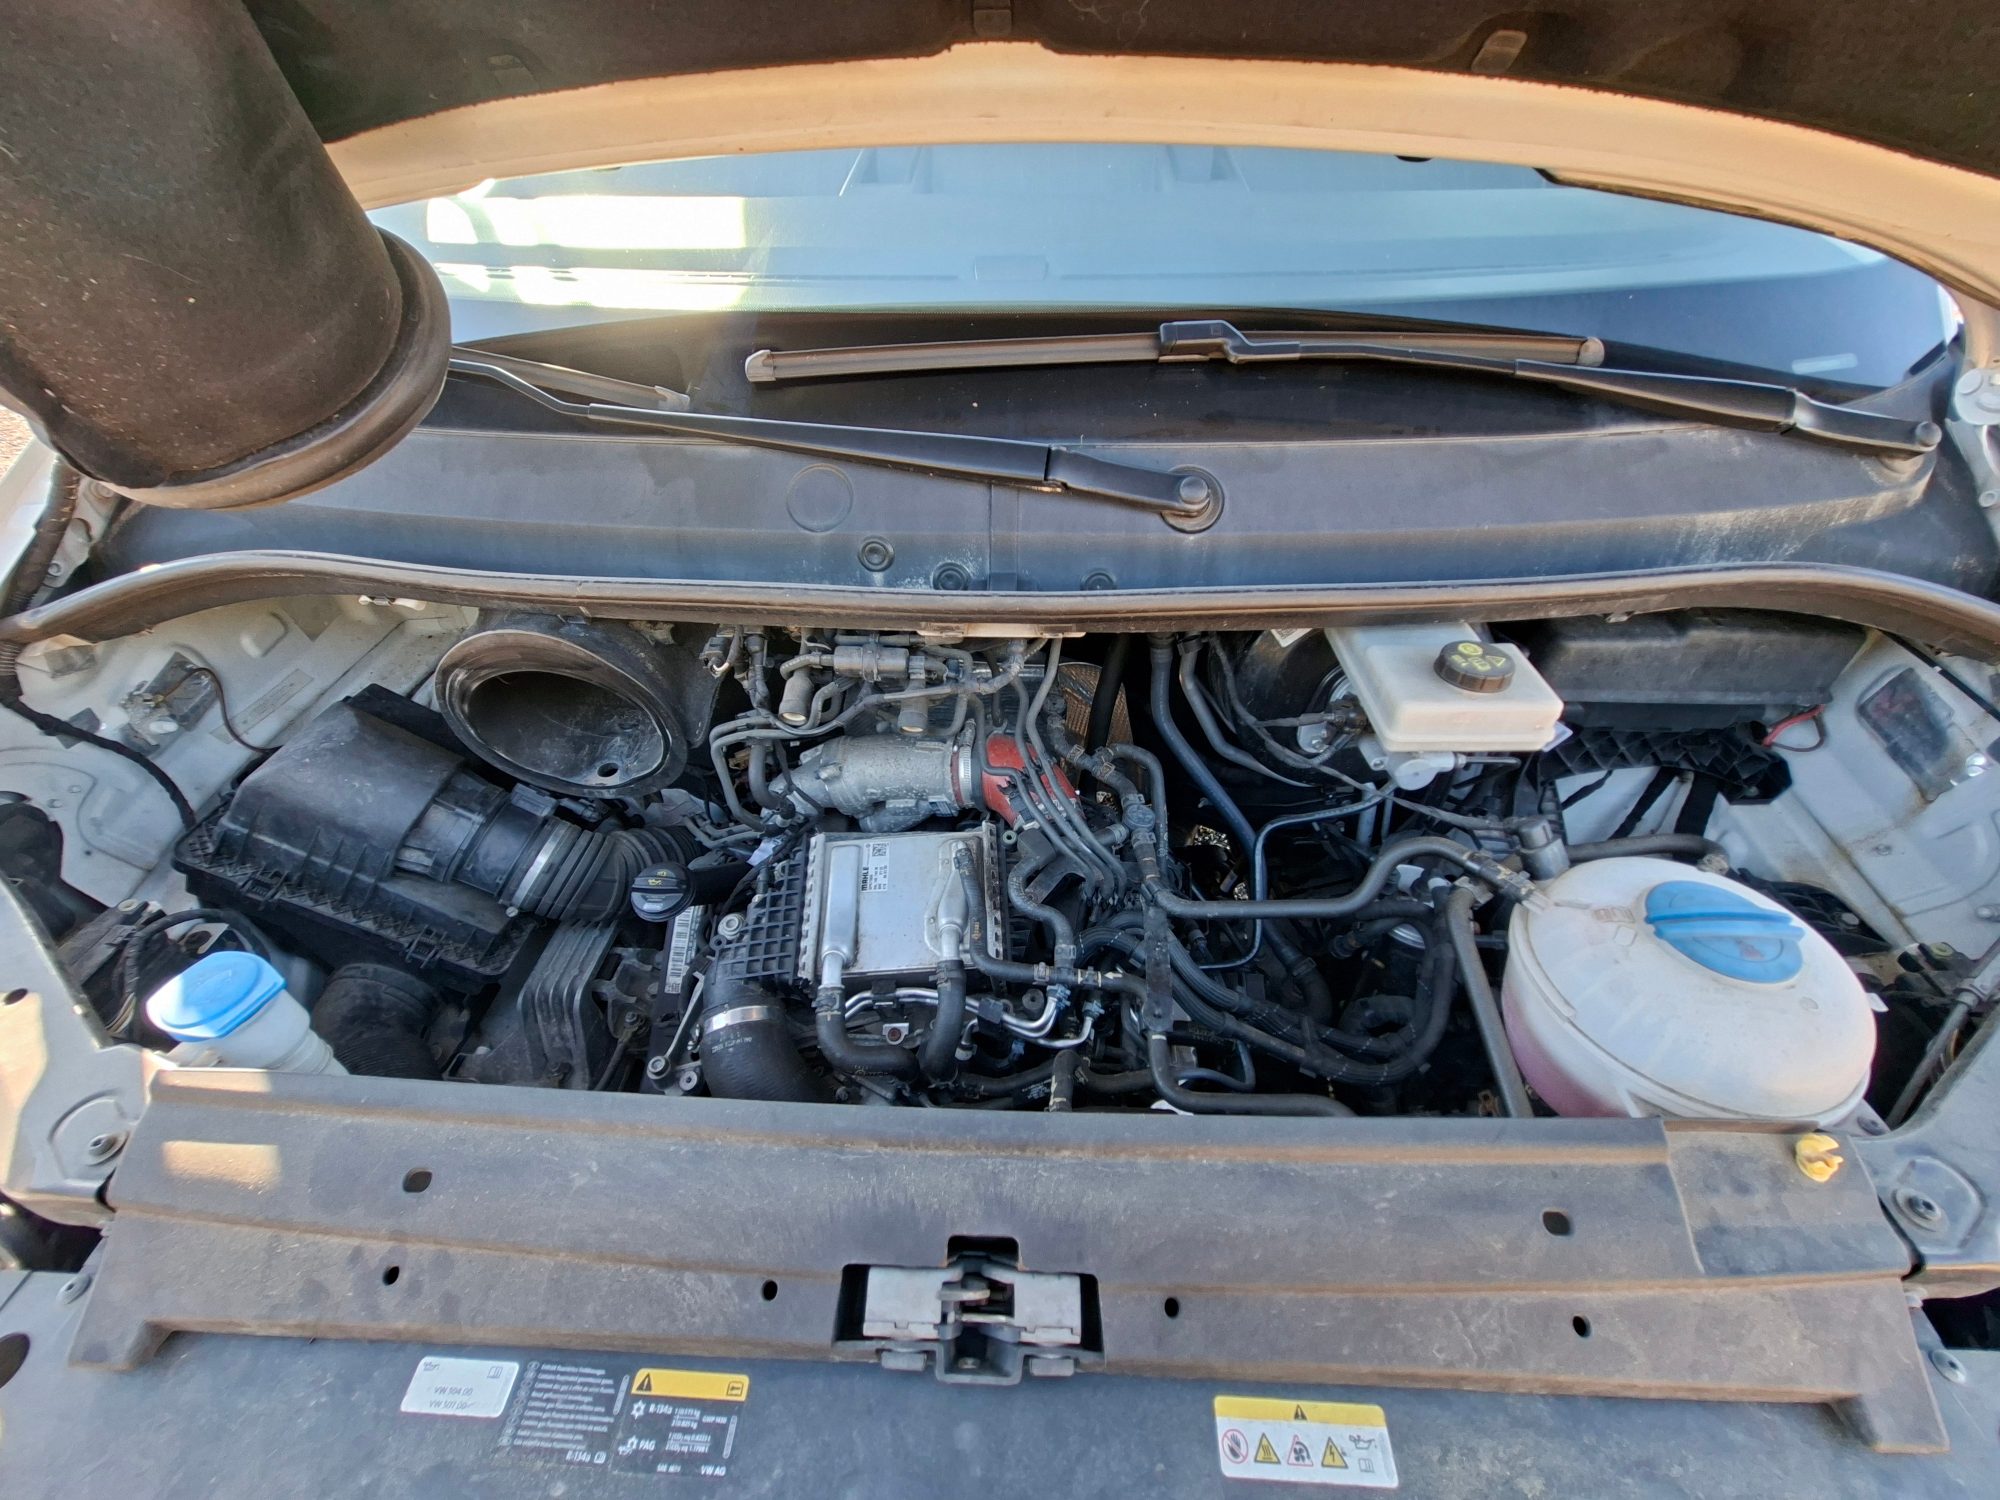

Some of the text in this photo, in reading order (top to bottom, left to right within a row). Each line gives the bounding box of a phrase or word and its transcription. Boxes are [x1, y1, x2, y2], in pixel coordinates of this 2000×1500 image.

[861, 866, 869, 891] MAHLE
[434, 1385, 447, 1394] VW
[429, 1399, 442, 1408] VW
[648, 1403, 673, 1415] R-134a
[638, 1439, 656, 1451] PAG
[700, 1464, 727, 1476] VW AG
